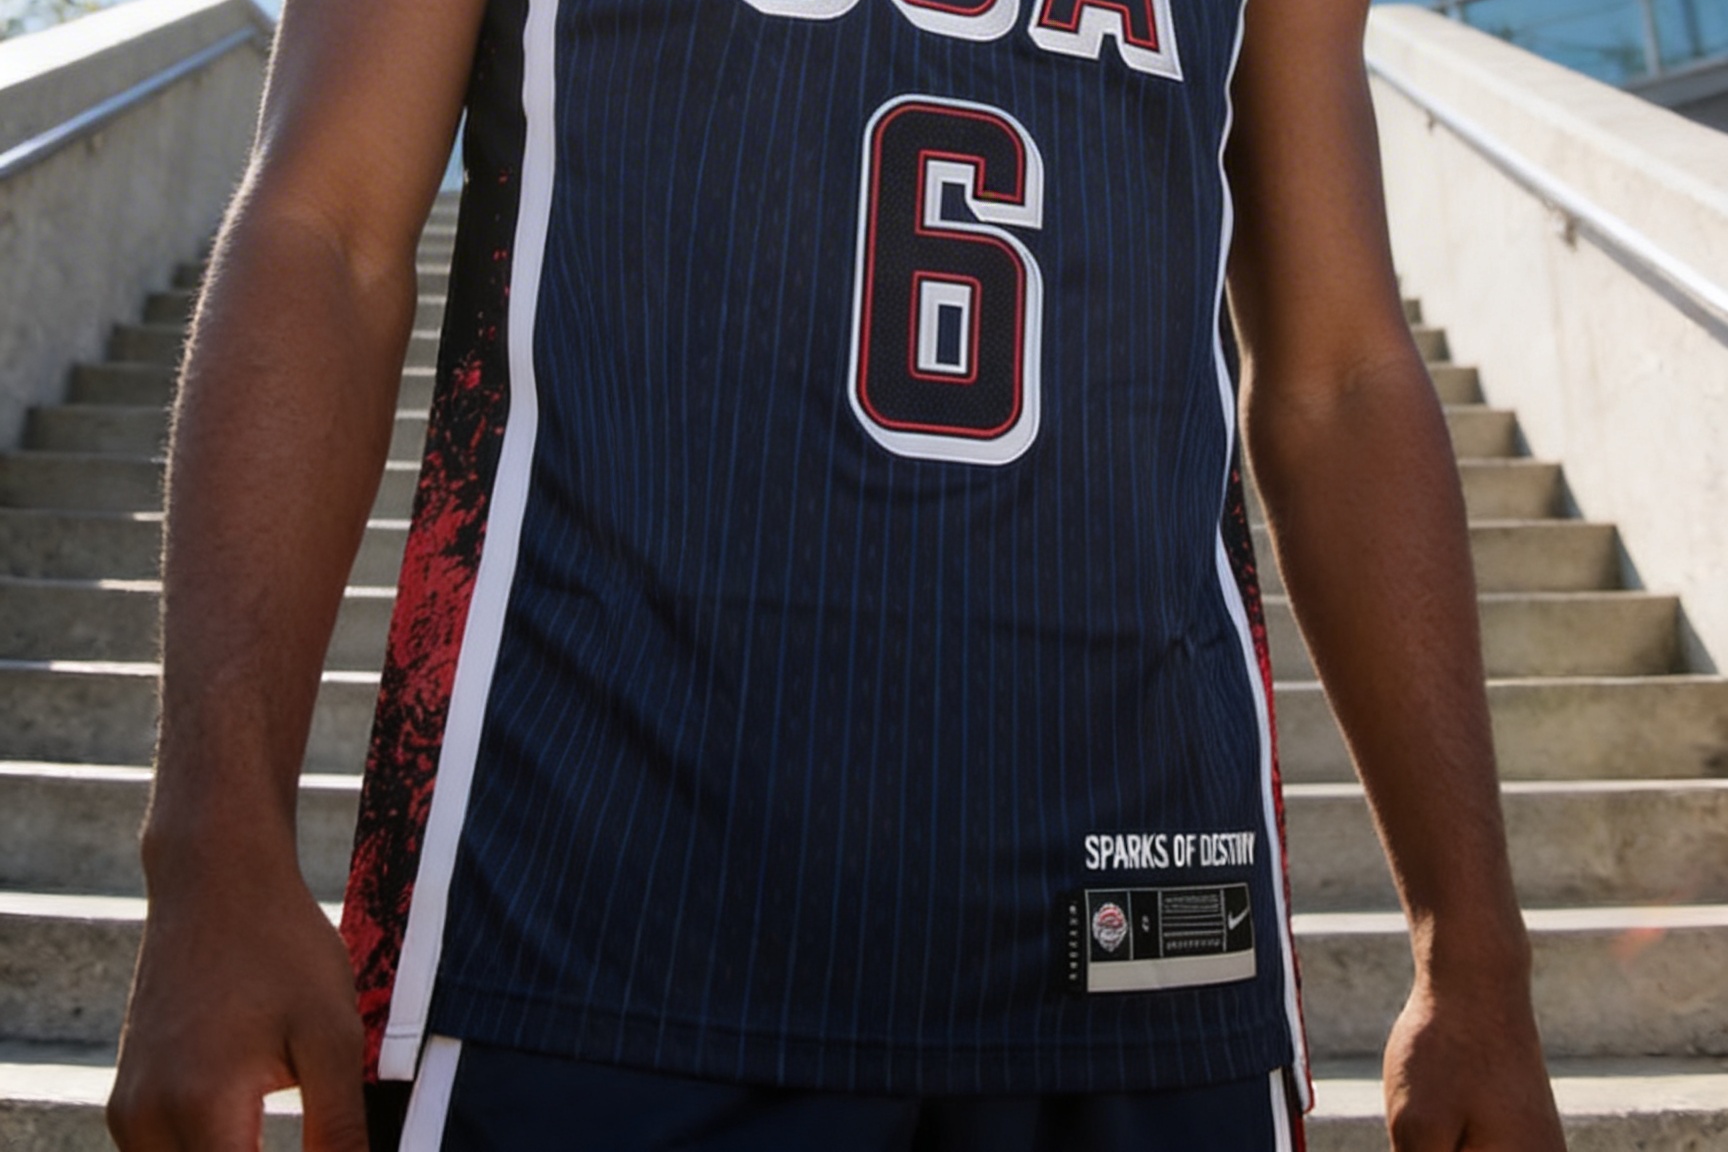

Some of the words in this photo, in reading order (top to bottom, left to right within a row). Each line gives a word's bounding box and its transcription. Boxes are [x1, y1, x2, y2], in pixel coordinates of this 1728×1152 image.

[847, 92, 1044, 466] 6
[1084, 833, 1170, 871] SPARKS
[1173, 833, 1197, 868] OF
